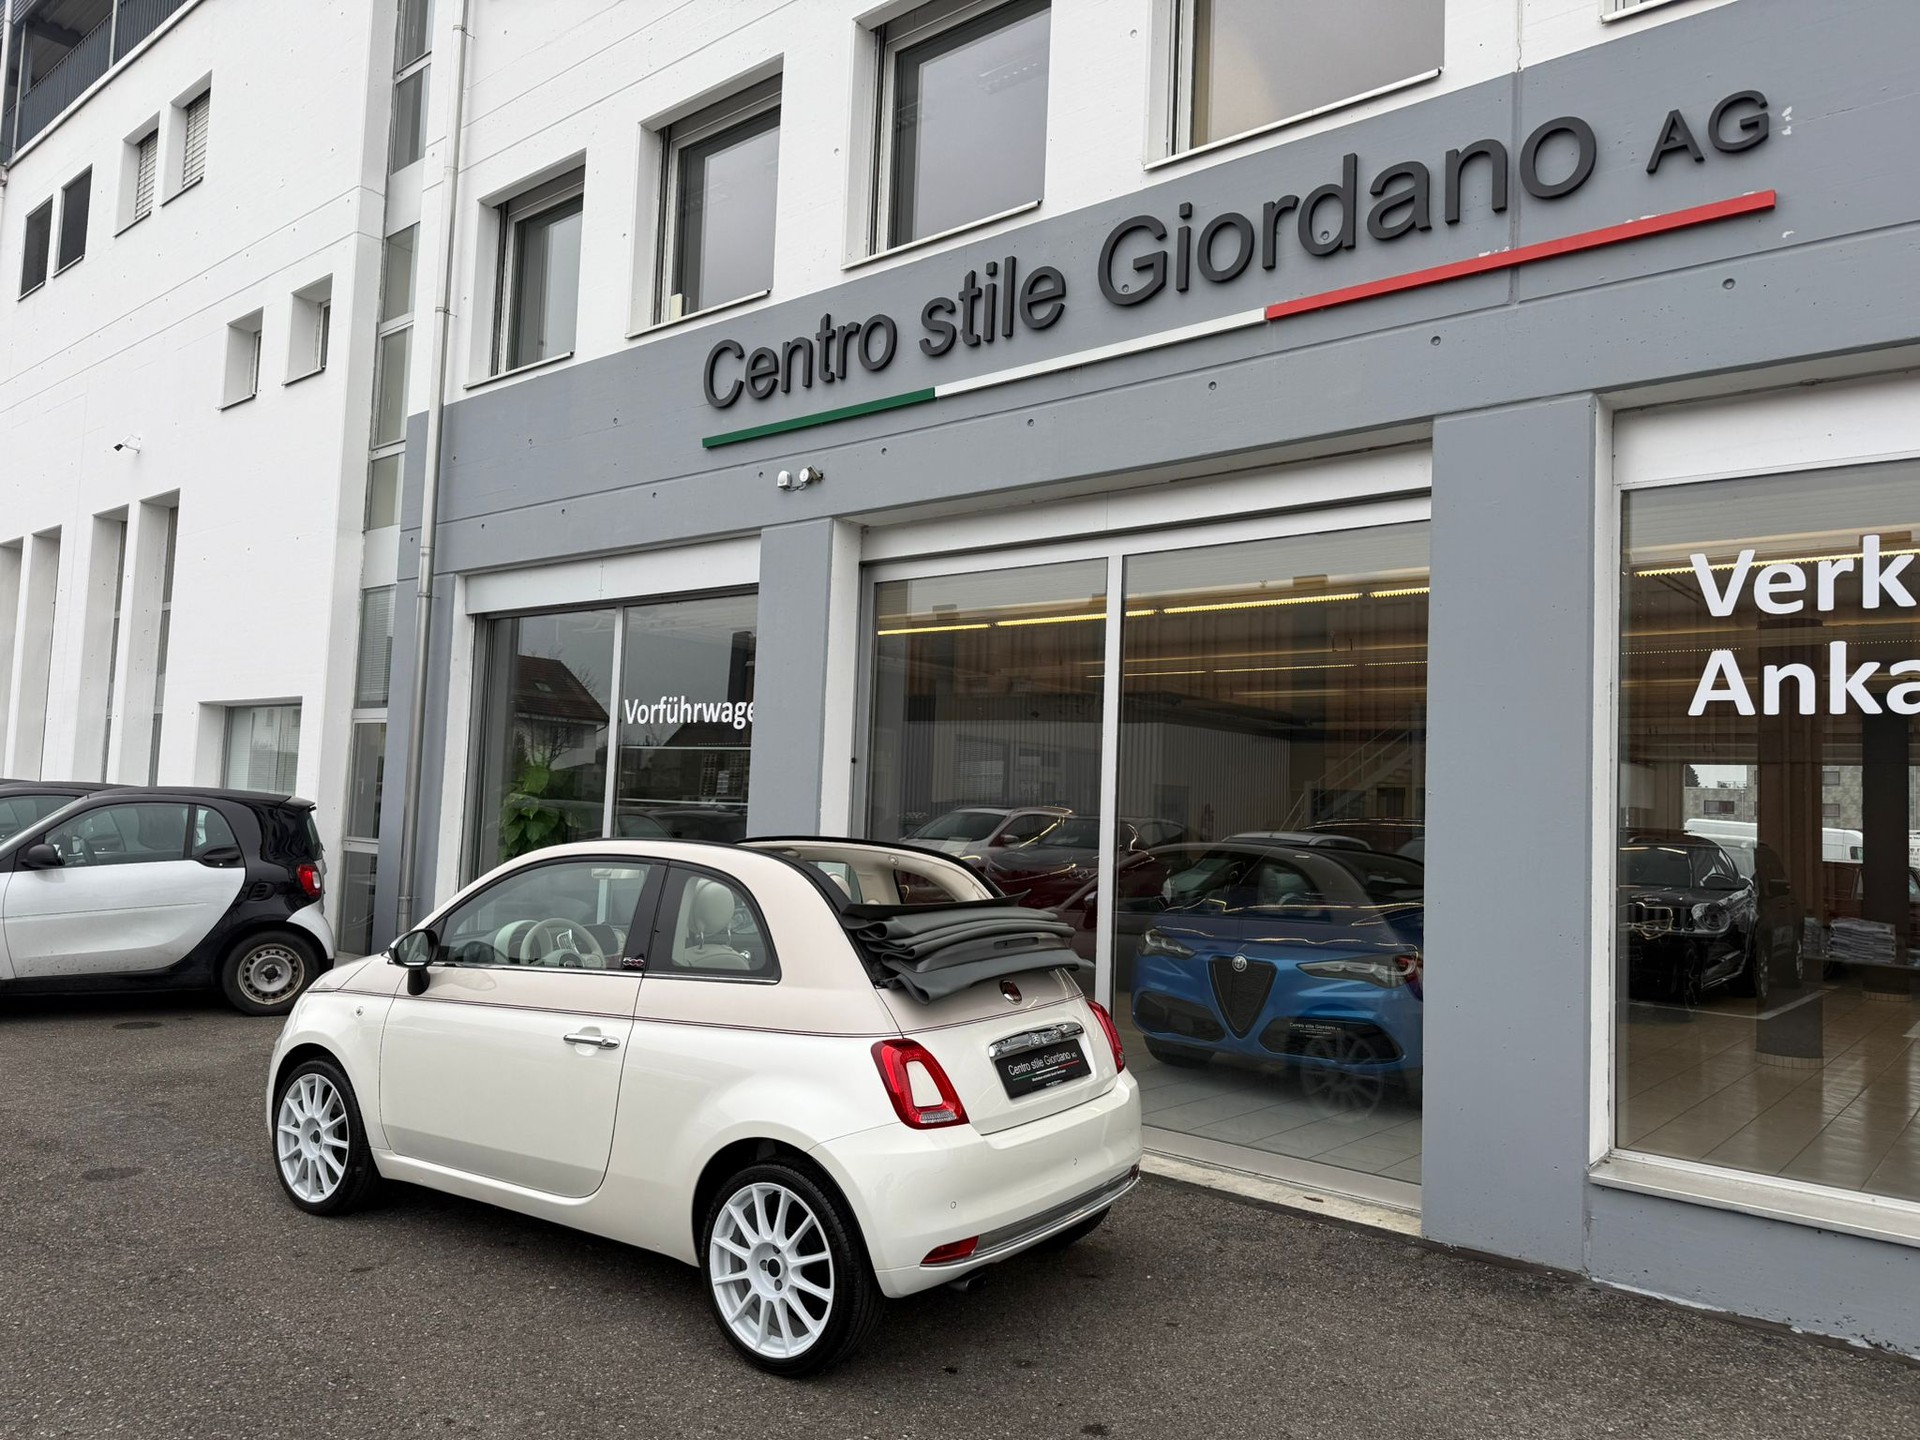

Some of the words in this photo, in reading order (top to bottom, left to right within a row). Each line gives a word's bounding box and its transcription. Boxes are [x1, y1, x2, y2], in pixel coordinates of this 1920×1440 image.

[703, 313, 897, 408] Centro
[919, 255, 1066, 357] stile
[1098, 116, 1597, 306] Giordano
[1646, 89, 1771, 175] AG
[1689, 535, 1917, 617] Verk
[1688, 641, 1920, 716] Anka
[1008, 1062, 1031, 1076] Centro
[1031, 1057, 1045, 1070] stile
[1043, 1051, 1071, 1066] Giordano
